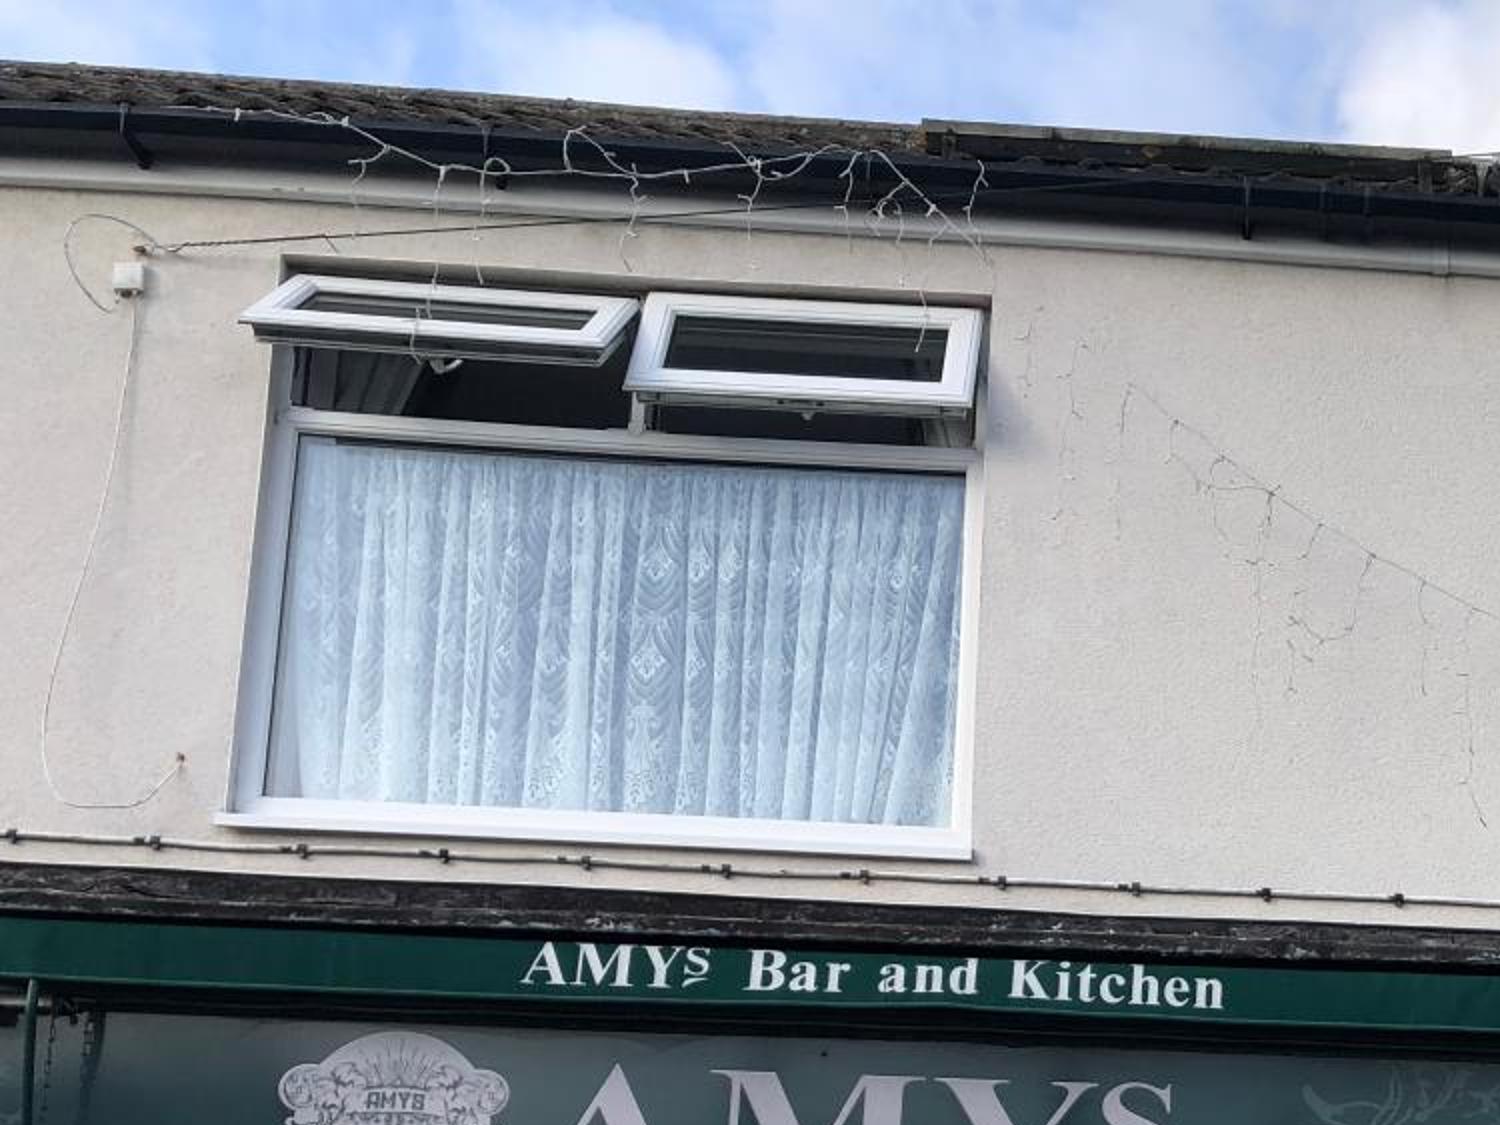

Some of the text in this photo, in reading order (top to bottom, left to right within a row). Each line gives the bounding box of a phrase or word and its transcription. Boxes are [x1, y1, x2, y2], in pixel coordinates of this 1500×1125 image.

[742, 949, 851, 993] Bar
[877, 957, 979, 995] and
[1008, 959, 1224, 1010] Kitchen
